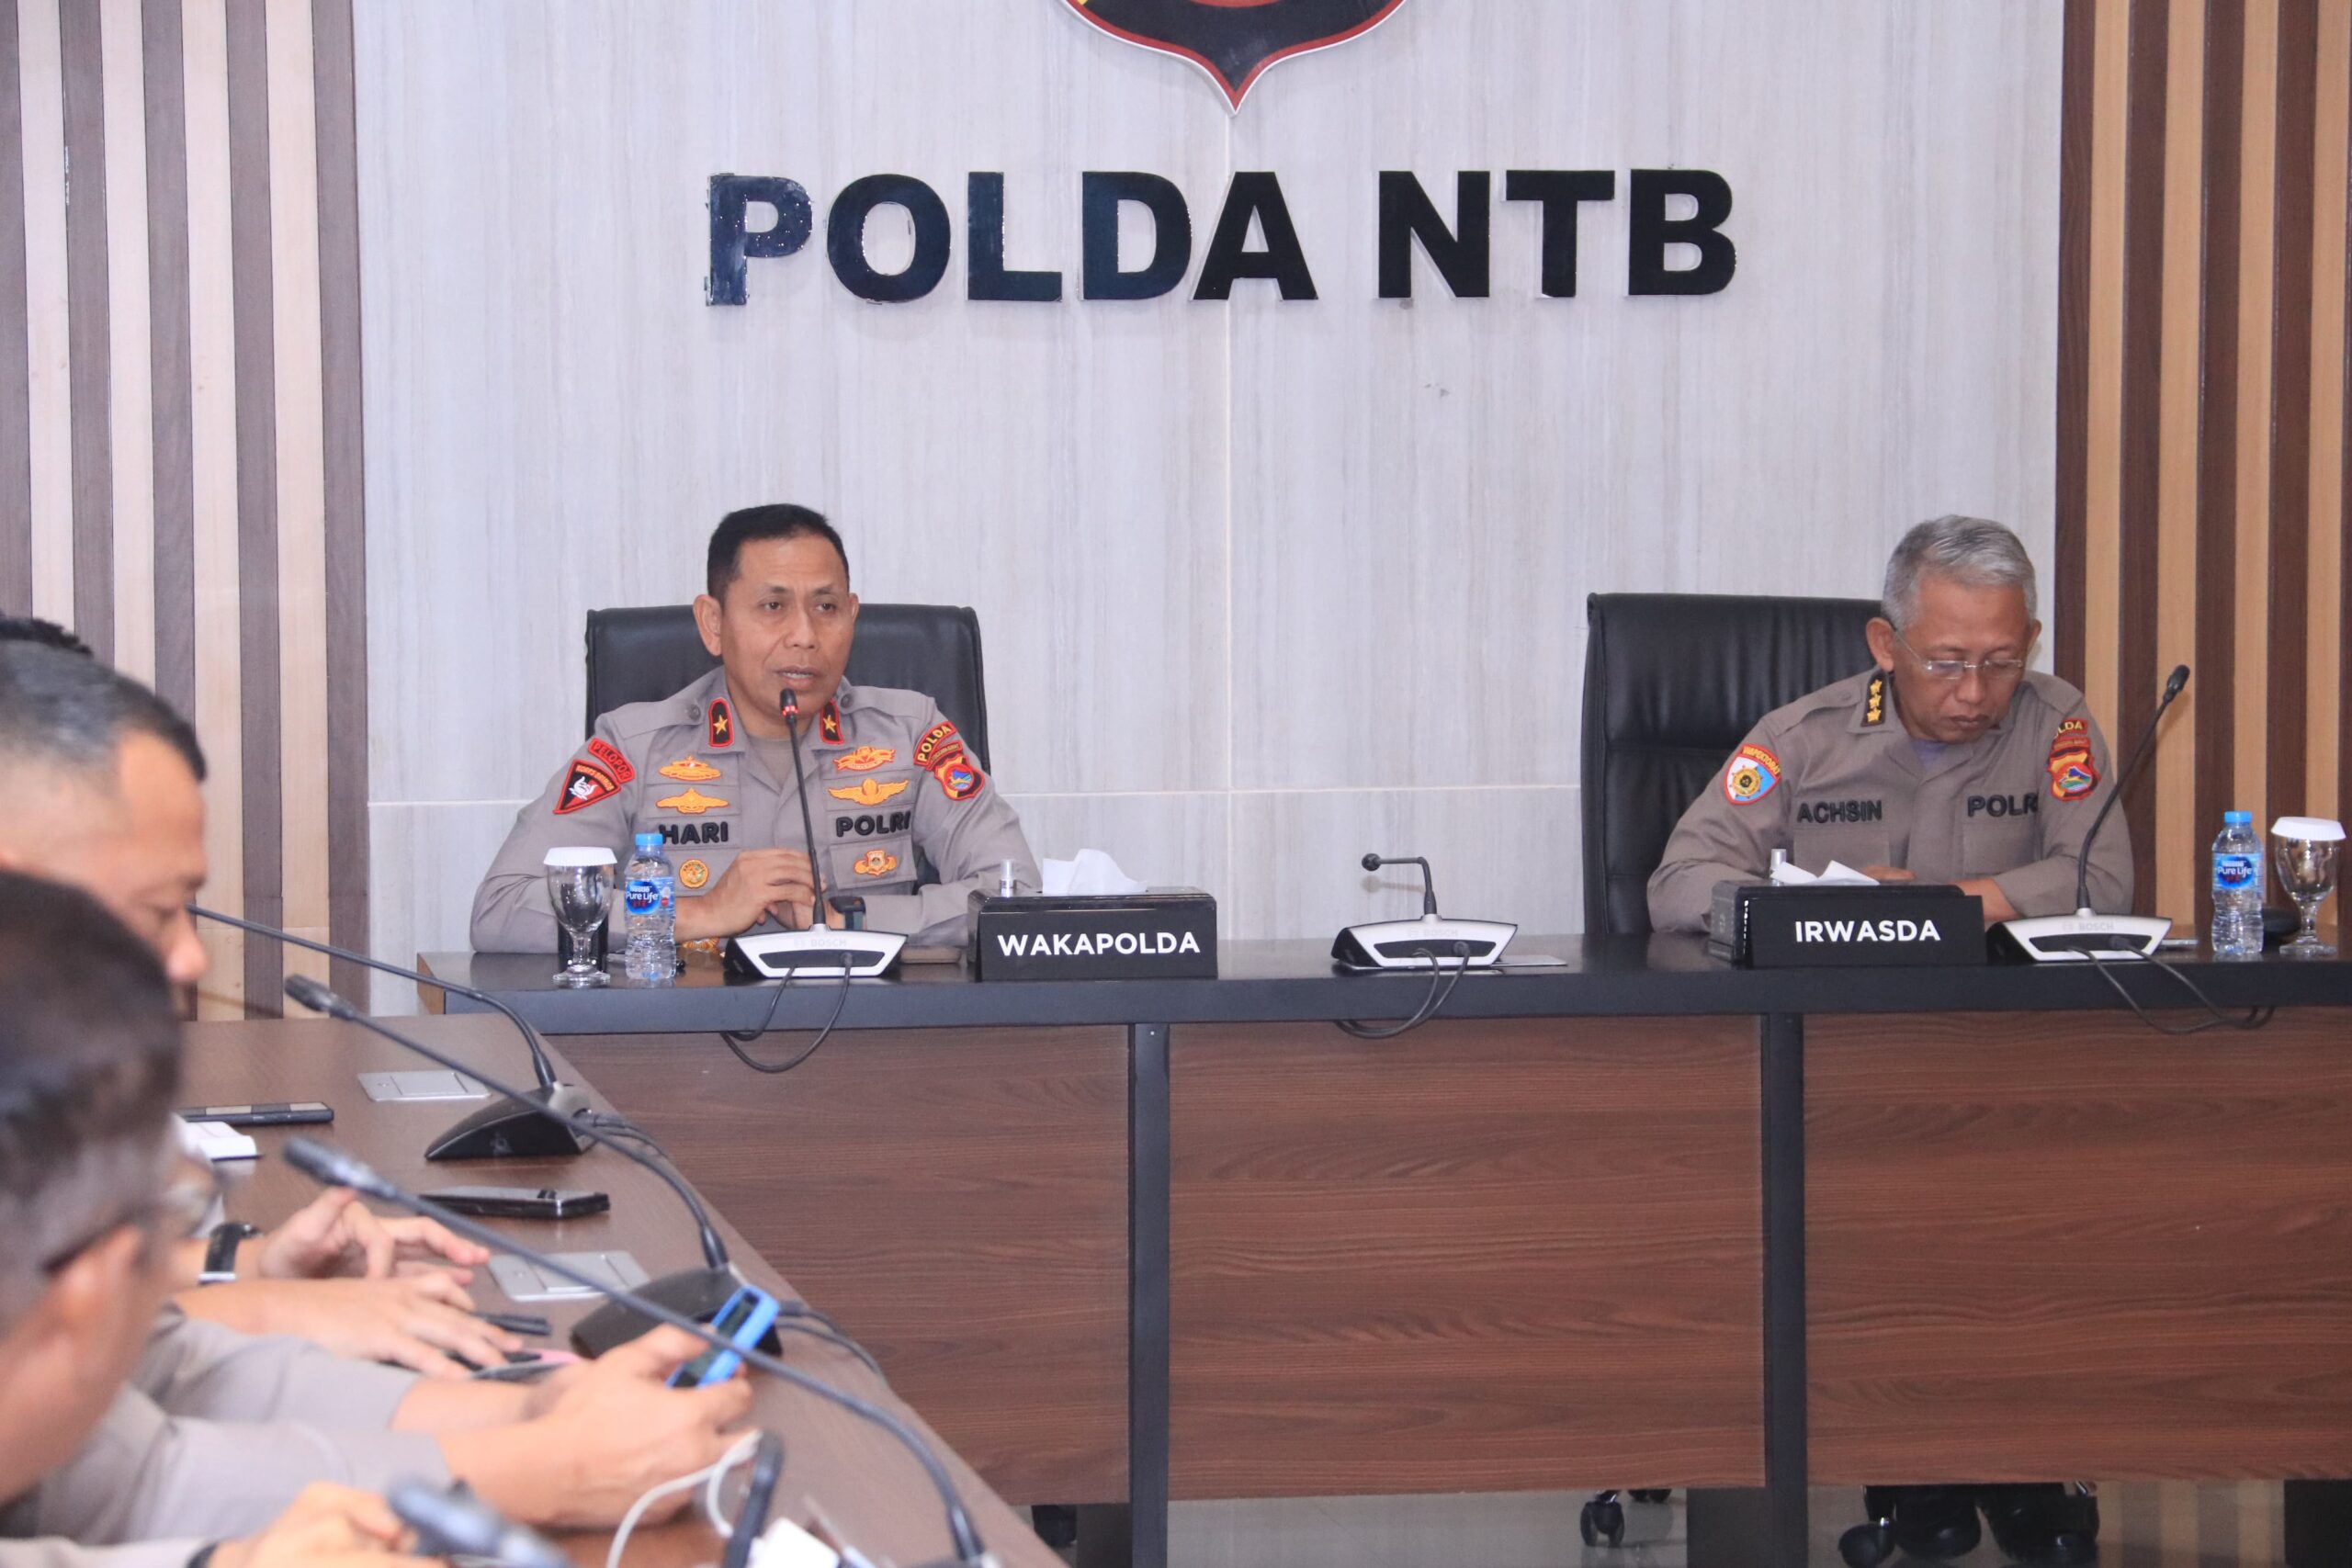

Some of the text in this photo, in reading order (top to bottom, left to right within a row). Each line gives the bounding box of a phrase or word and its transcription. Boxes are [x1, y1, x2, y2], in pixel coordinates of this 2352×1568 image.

[708, 169, 1736, 305] POLDA NTB
[917, 724, 952, 762] POLDA
[593, 740, 631, 779] PELOPOR
[1797, 800, 1882, 824] ACHSIN
[1967, 792, 2038, 818] POLR
[659, 821, 729, 844] HARI
[835, 811, 911, 837] POLRI
[626, 892, 659, 904] Pure Life
[1795, 919, 1941, 942] IRWASDA
[2078, 921, 2114, 931] BOSCH
[810, 938, 847, 947] BOSCH
[997, 931, 1201, 956] WAKAPOLDA
